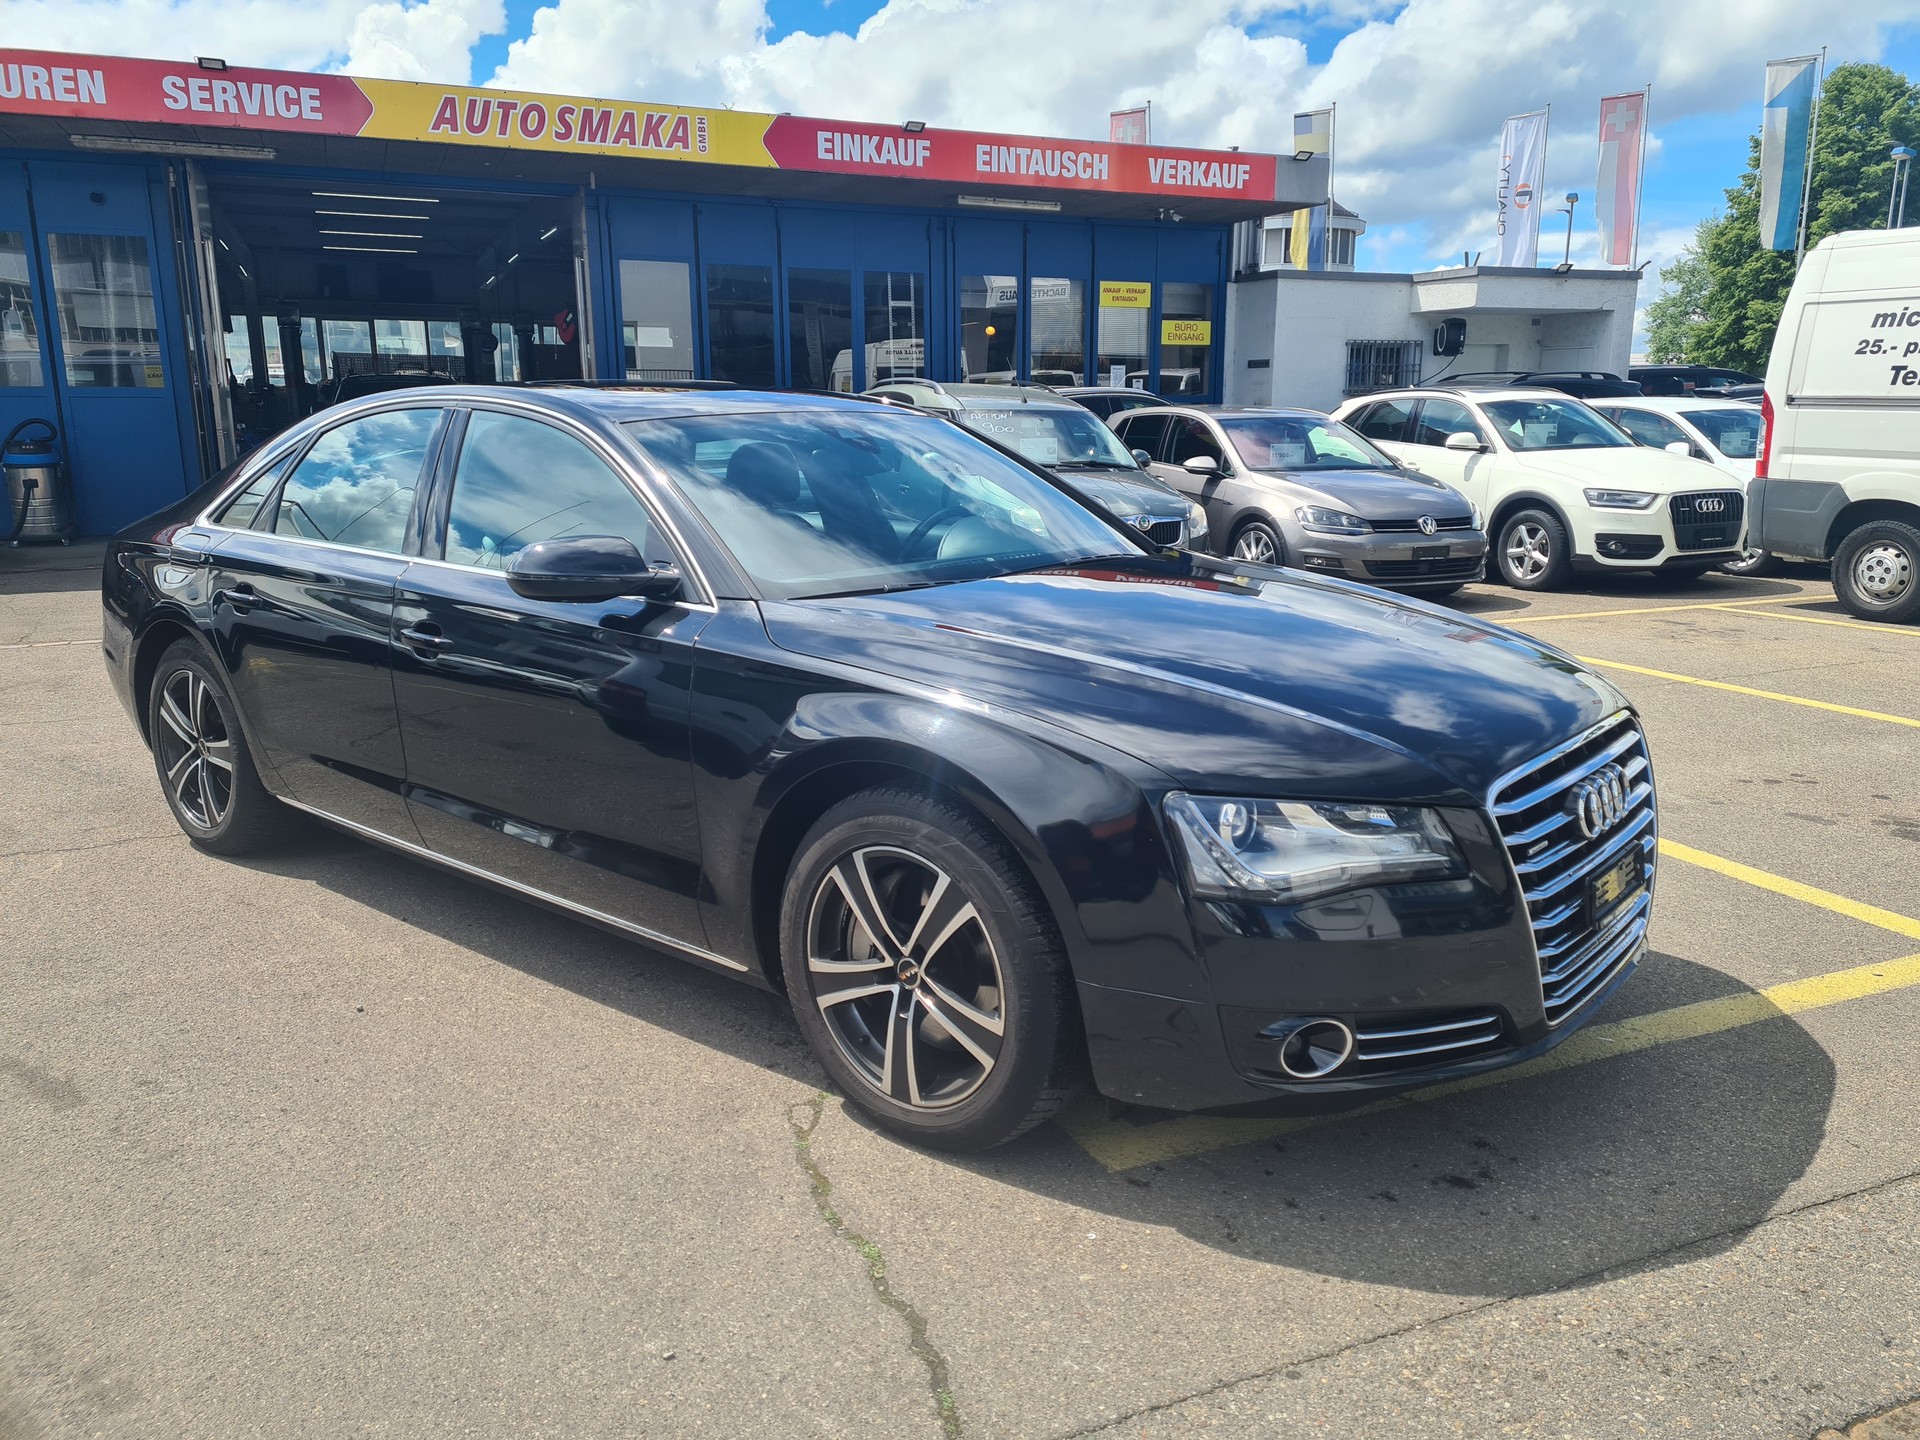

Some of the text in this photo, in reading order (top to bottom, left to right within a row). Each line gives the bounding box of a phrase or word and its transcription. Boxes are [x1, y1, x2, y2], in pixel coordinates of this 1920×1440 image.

[0, 63, 107, 104] UREN
[162, 75, 323, 121] SERVICE
[430, 96, 707, 153] AUTO SMAKA GMBH
[817, 130, 1250, 189] EINKAUF EINTAUSCH VERKAUF
[1112, 295, 1138, 303] EINTAUSCH
[1174, 321, 1198, 332] BÜRO
[1167, 333, 1205, 342] EINGANG
[1854, 339, 1898, 355] 25.-
[1890, 365, 1920, 386] Te
